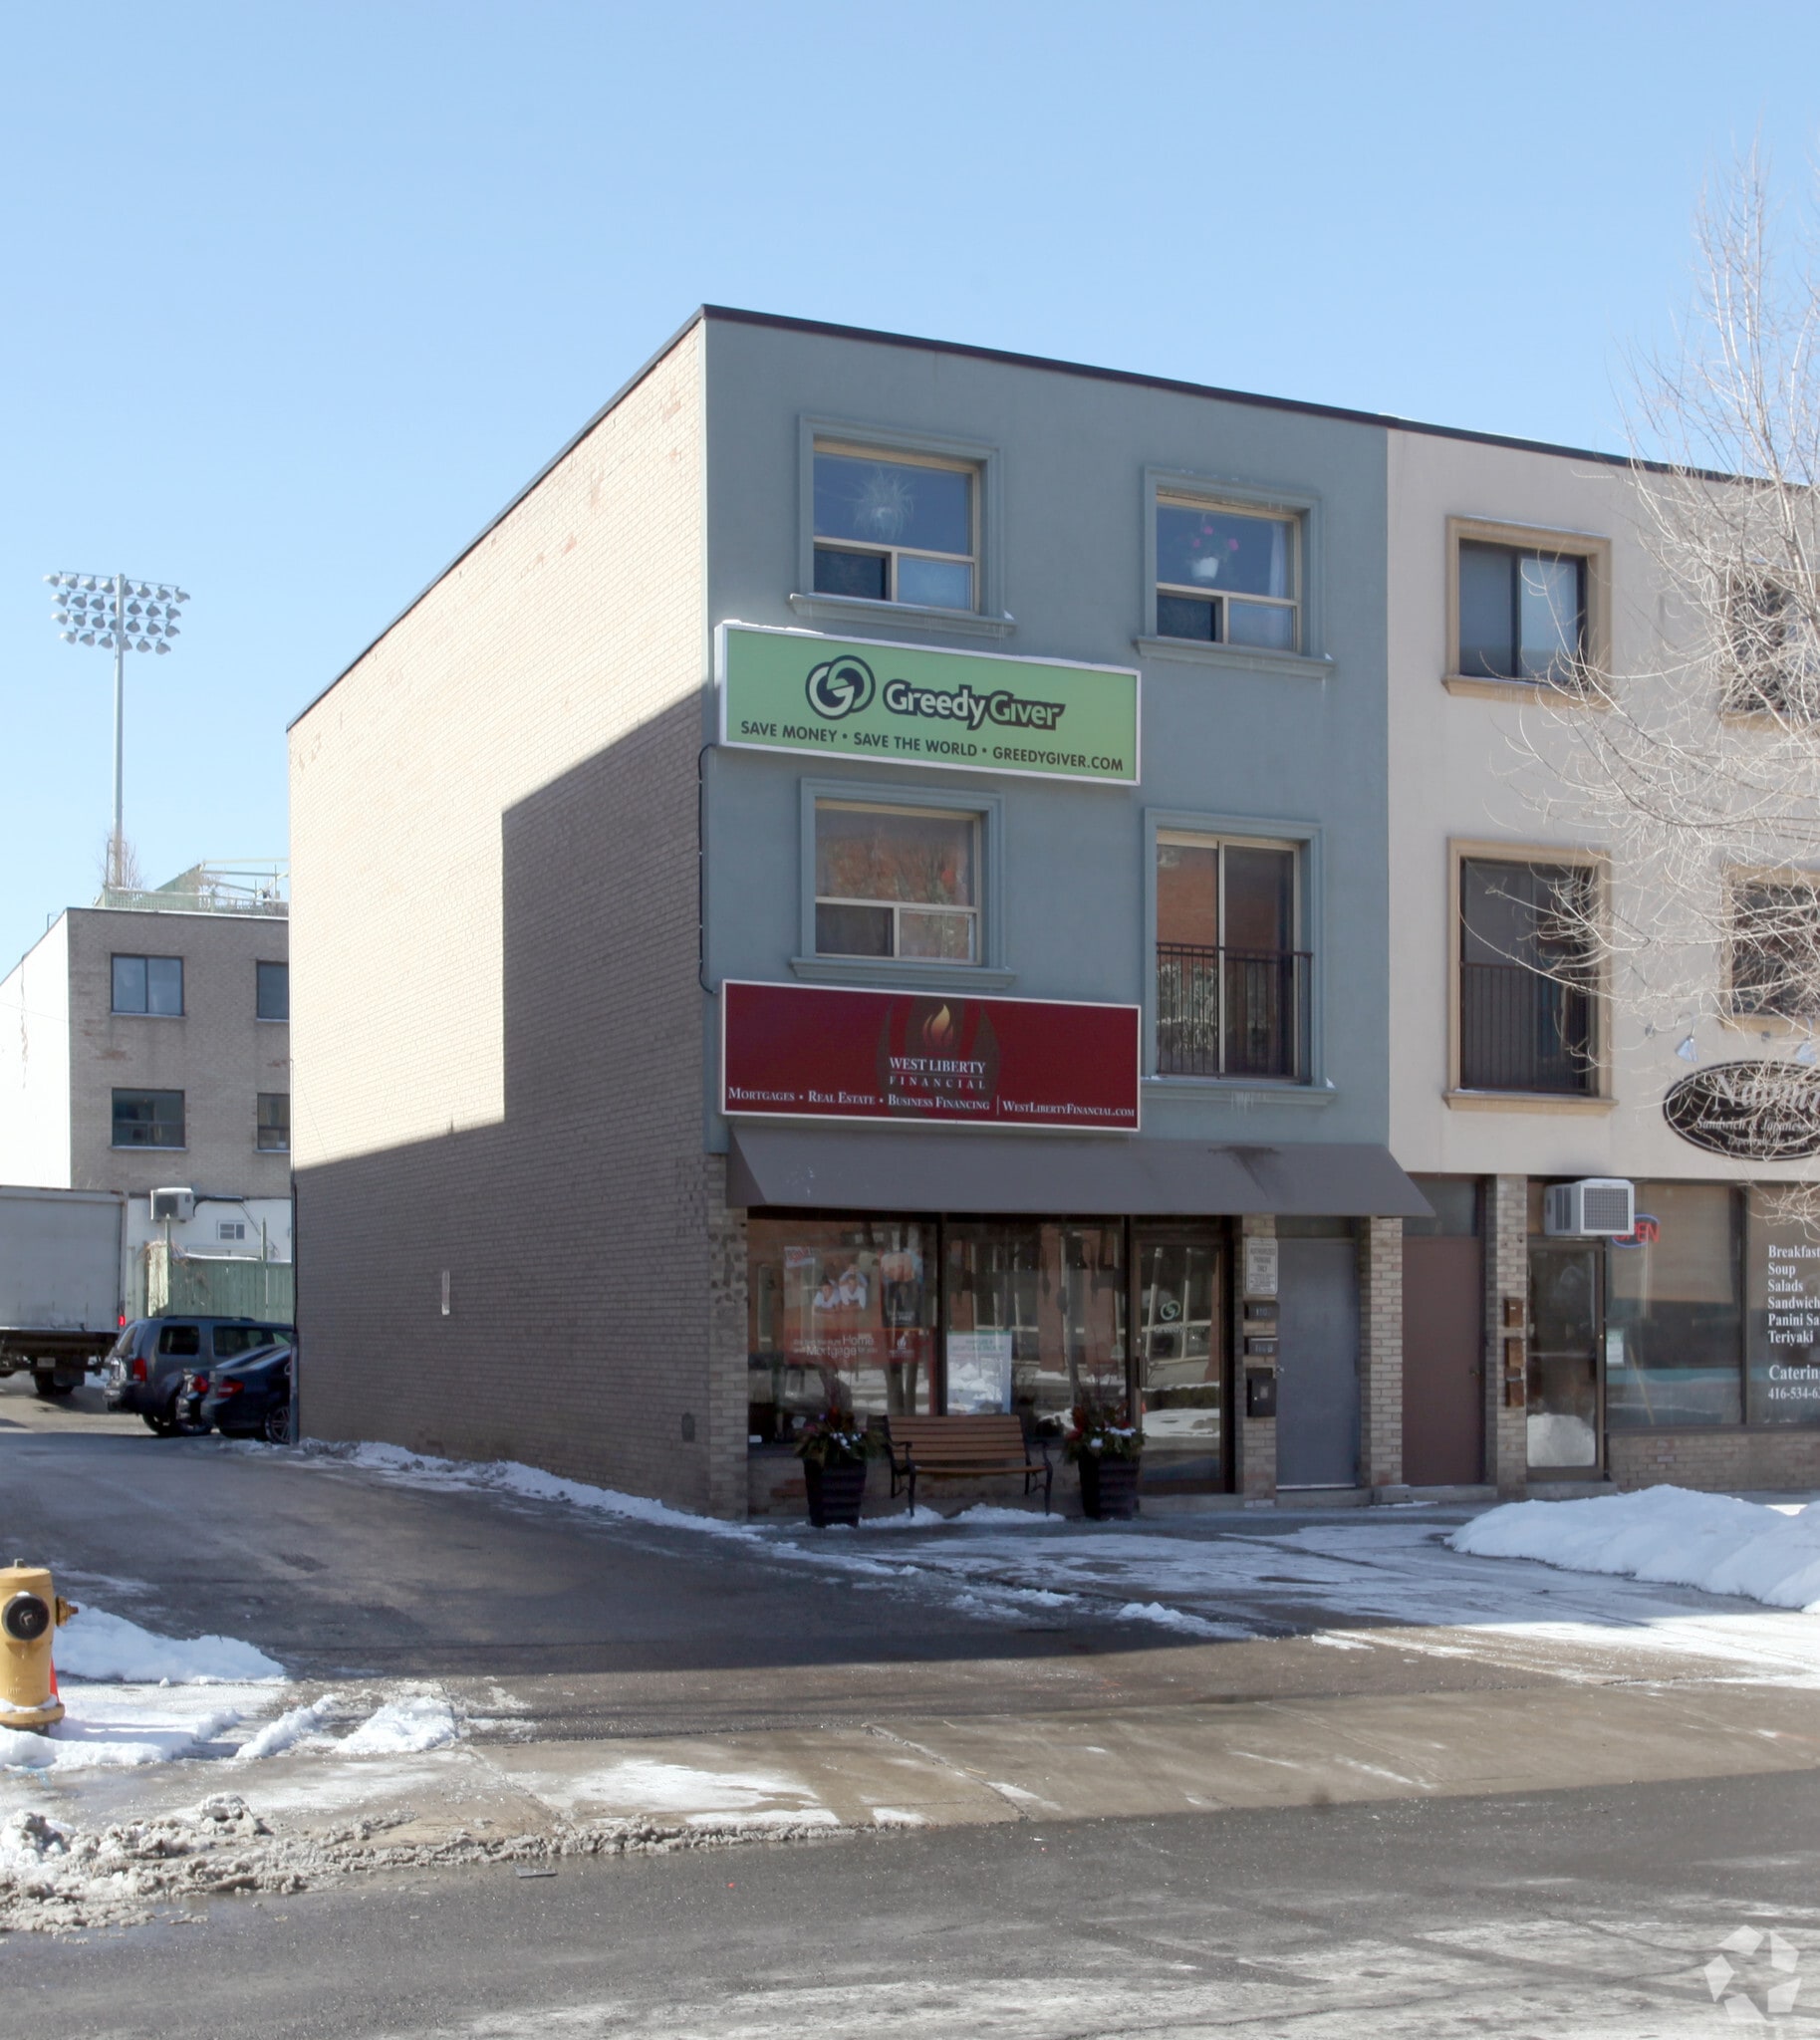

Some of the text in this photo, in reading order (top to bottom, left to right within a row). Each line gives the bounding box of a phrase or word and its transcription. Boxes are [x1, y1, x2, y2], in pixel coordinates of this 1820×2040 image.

[883, 678, 1066, 730] GreedyGiver
[741, 720, 1123, 772] SAVE MONEY SAVE THE WORLD GREEDYGIVER.COM
[890, 1057, 986, 1075] WEST LIBERTY
[890, 1076, 986, 1090] FINANCIAL
[1614, 1221, 1661, 1244] EN
[1768, 1262, 1796, 1279] Soup
[1768, 1279, 1804, 1293] Salads
[1768, 1313, 1820, 1327] Panini Sa
[1768, 1330, 1814, 1347] Teriyaki
[806, 1345, 857, 1358] Mortgage
[1769, 1364, 1820, 1381] Caterin
[1768, 1387, 1820, 1400] 416-534-6
